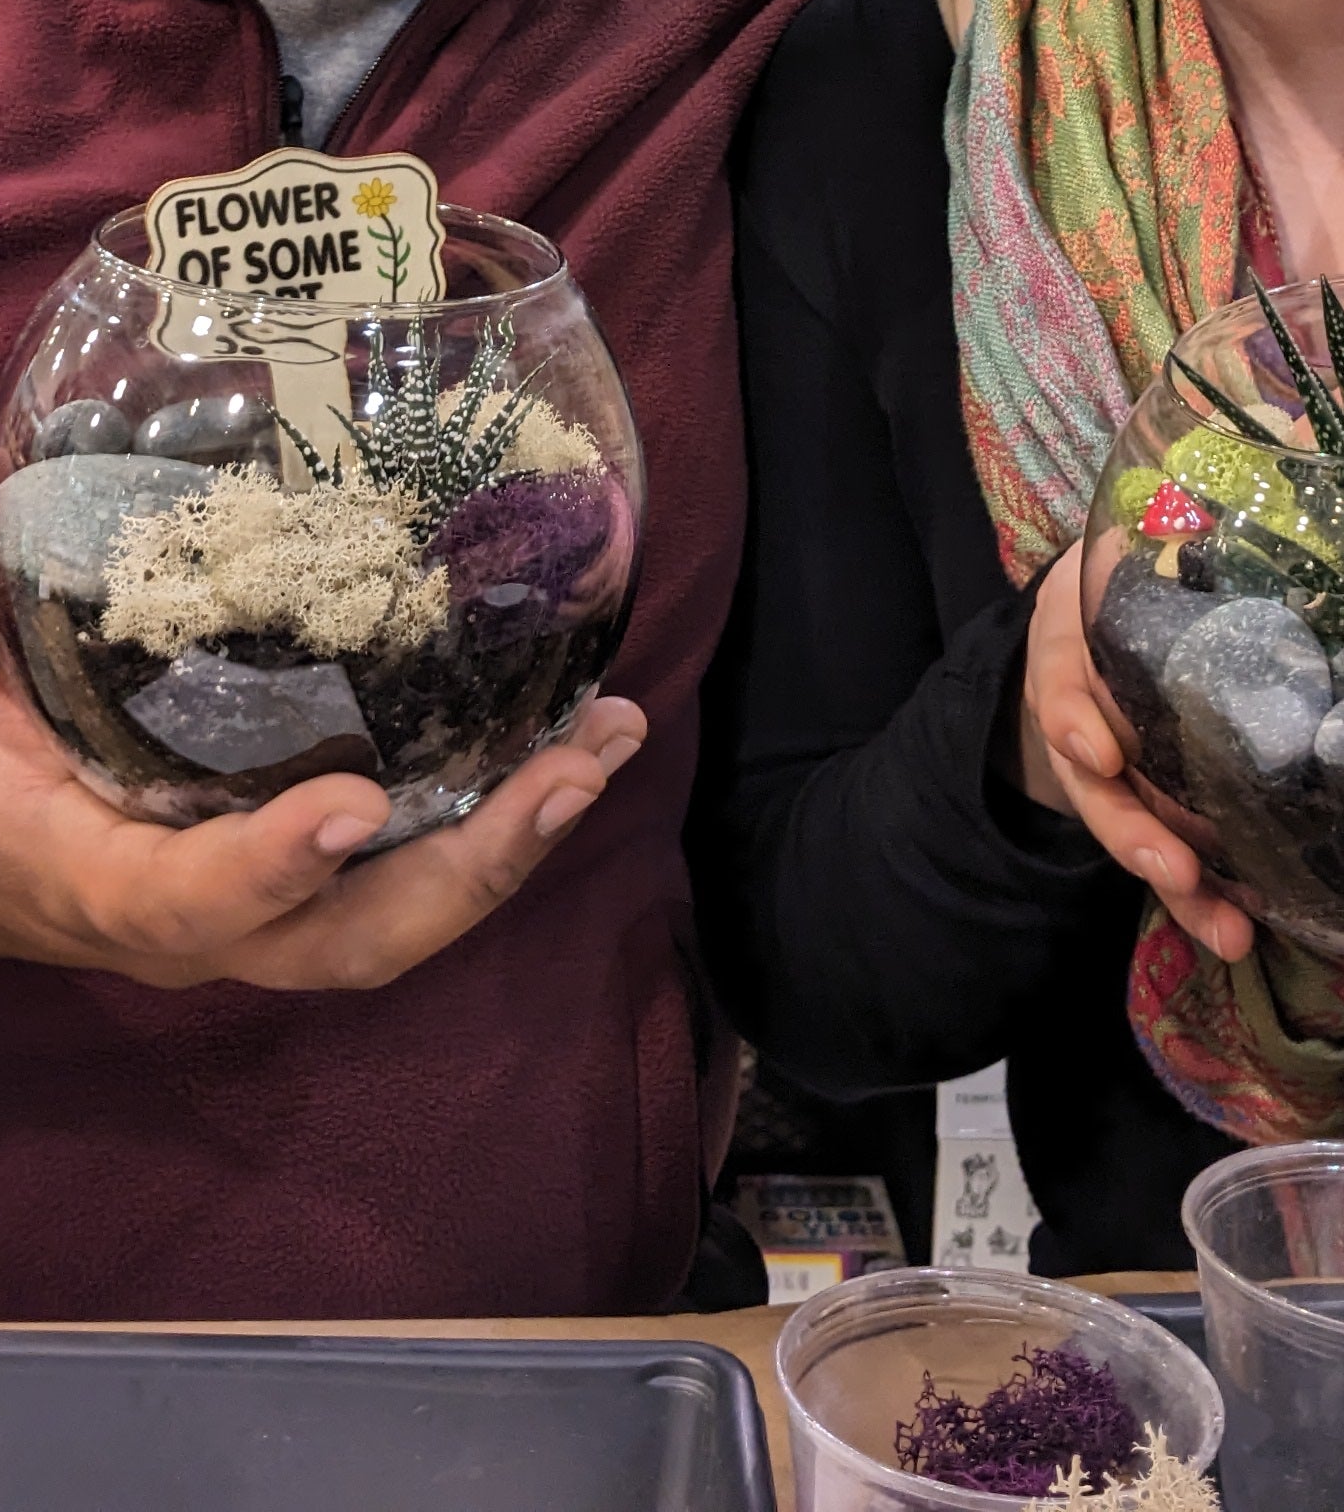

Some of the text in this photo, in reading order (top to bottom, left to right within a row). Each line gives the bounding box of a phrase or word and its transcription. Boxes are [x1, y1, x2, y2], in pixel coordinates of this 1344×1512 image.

[175, 182, 341, 239] FLOWER
[178, 229, 362, 288] OF SOME
